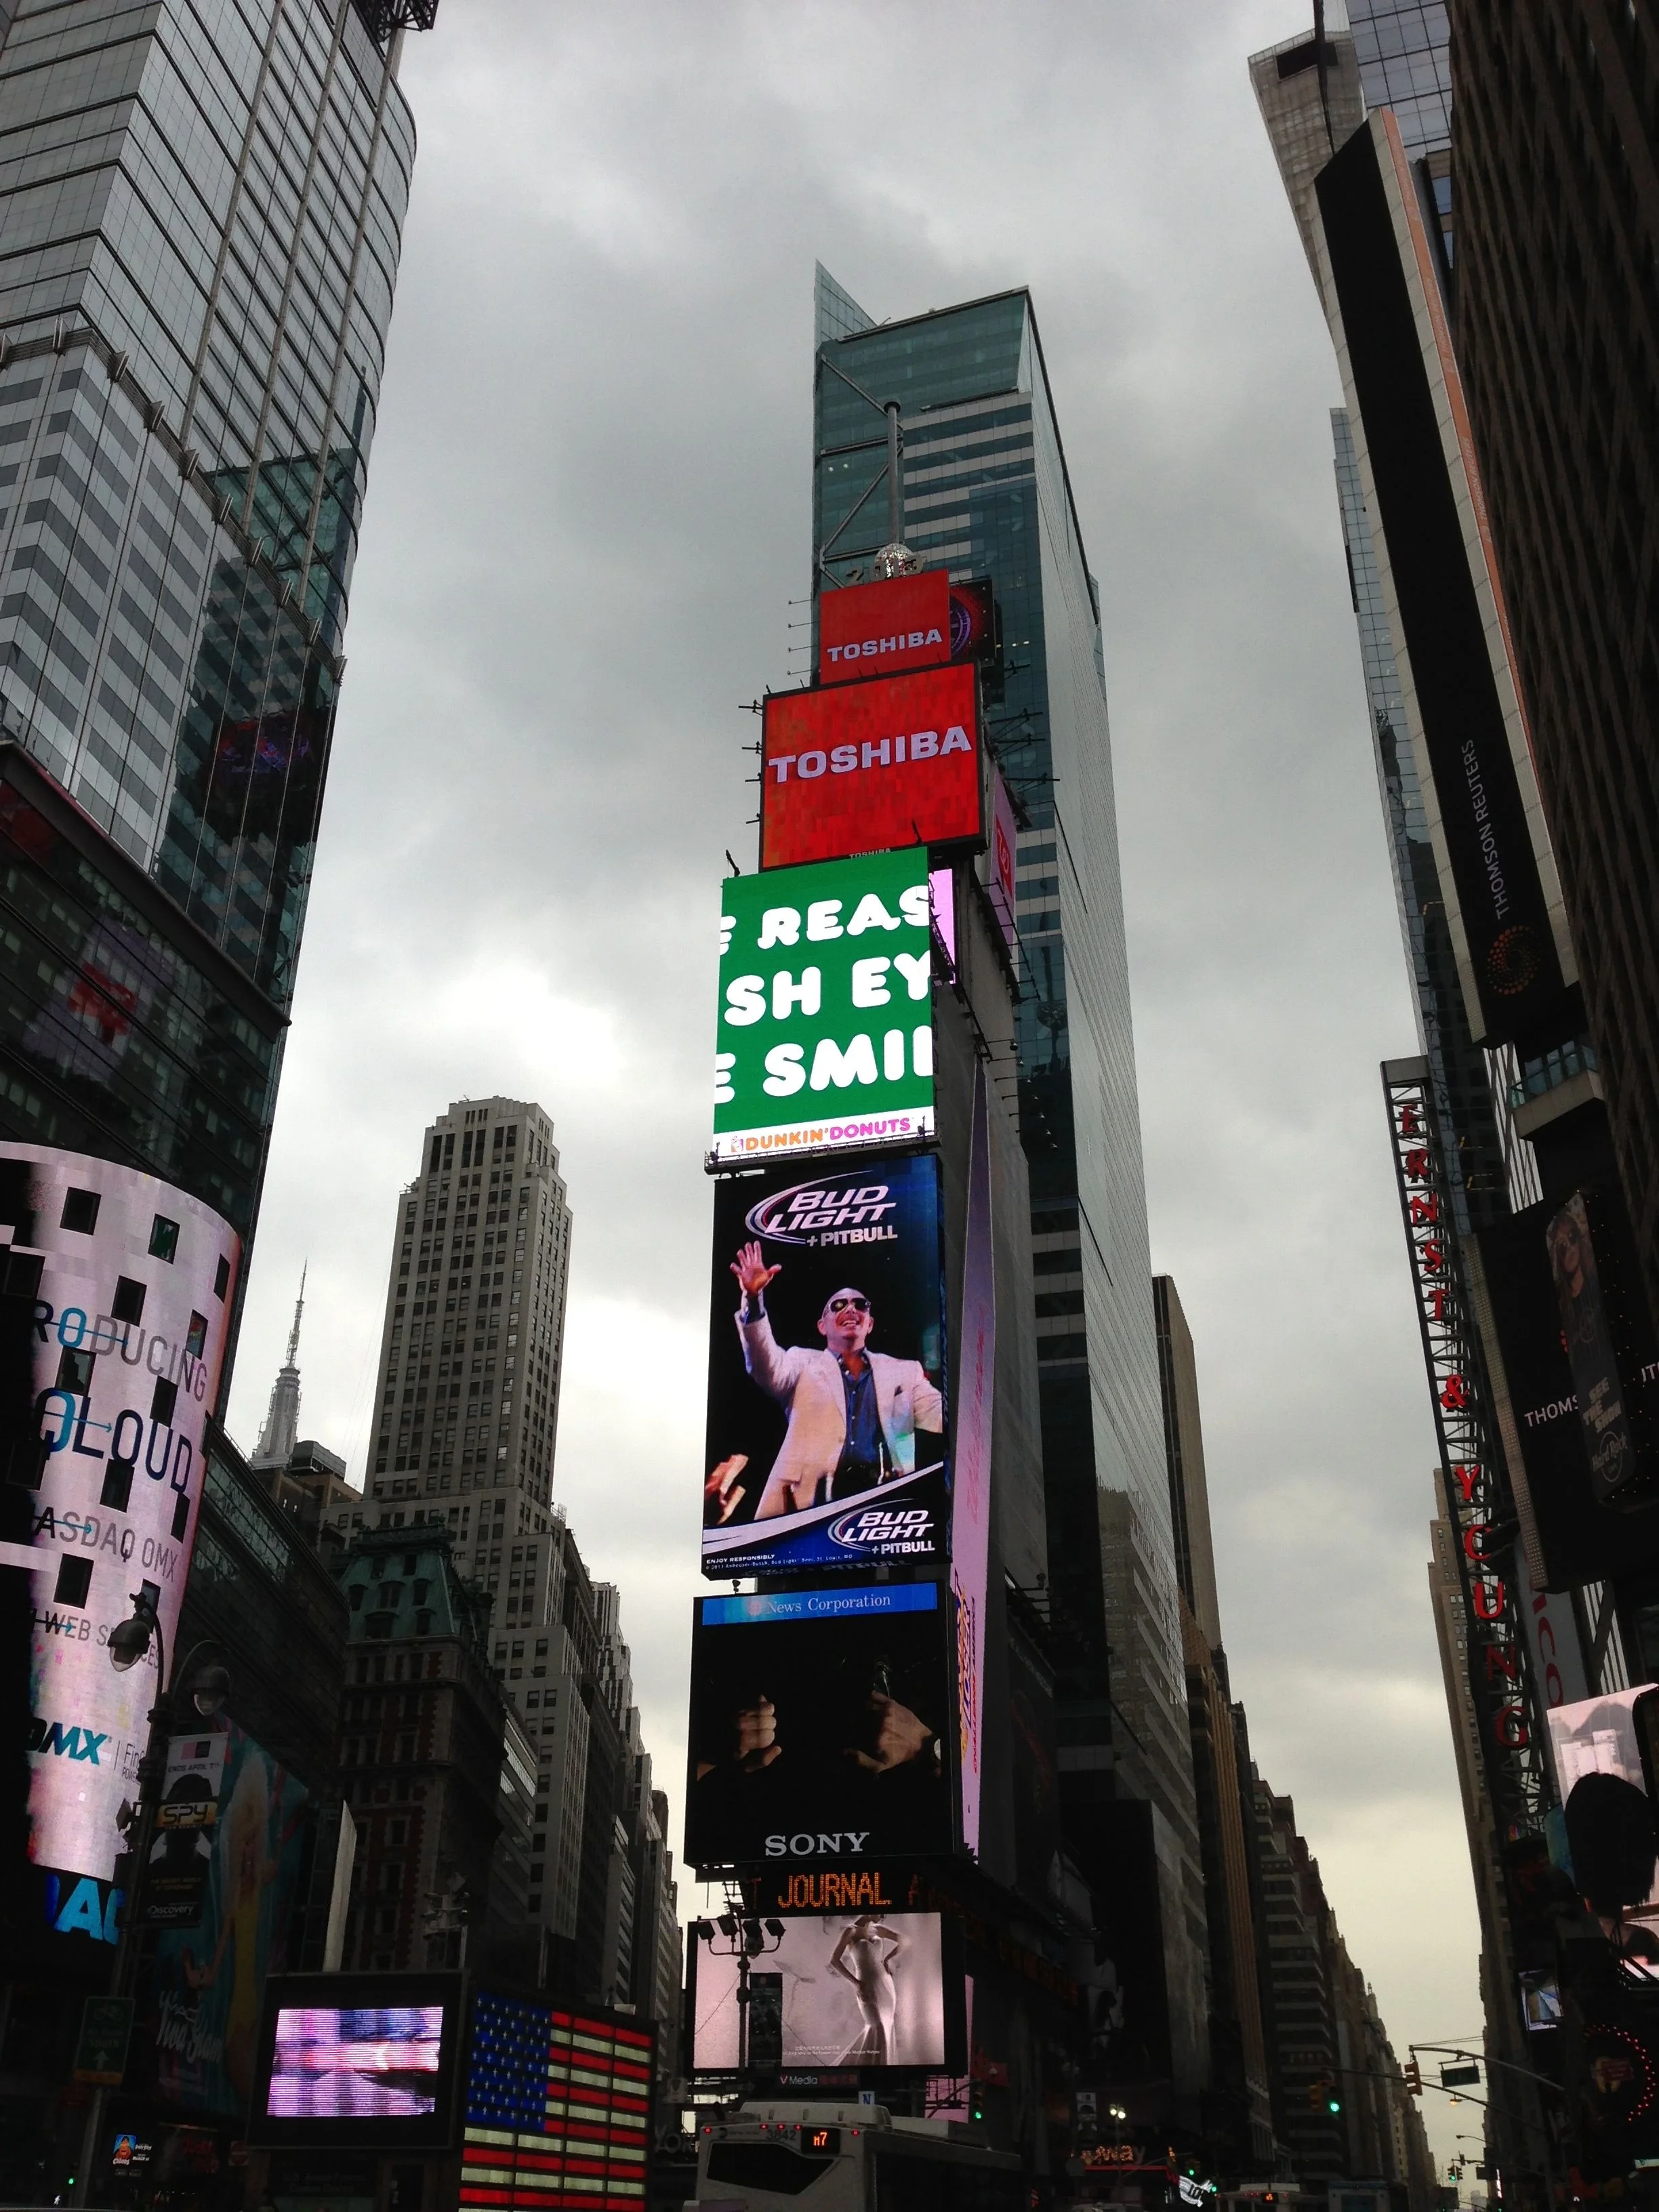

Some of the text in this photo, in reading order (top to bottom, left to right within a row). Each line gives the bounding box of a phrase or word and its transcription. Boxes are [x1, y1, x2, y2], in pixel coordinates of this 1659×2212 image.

[827, 629, 942, 662] TOSHIBA
[769, 725, 972, 783] TOSHIBA
[1462, 739, 1509, 920] THOMSON REUTERS
[757, 885, 928, 949] REAS
[724, 950, 930, 1025] SH EY
[830, 1117, 911, 1140] DONUTS
[787, 1185, 888, 1212] BUD
[764, 1203, 897, 1233] LIGHT
[821, 1225, 897, 1247] PITBULL
[1589, 1377, 1610, 1404] SEE
[1583, 1399, 1603, 1425] THE
[1595, 1400, 1622, 1433] SHOW
[1401, 1105, 1527, 1746] ERNST & YOUNG
[857, 1510, 928, 1528] BUD
[842, 1523, 934, 1542] LIGHT
[142, 1538, 178, 1583] OMX
[730, 1554, 775, 1562] RESPONSIBLY
[881, 1540, 935, 1555] PITBULL
[766, 1593, 890, 1614] News Corporation
[45, 1610, 91, 1641] WEB
[163, 1803, 208, 1824] SPY
[764, 1832, 869, 1857] SONY
[790, 2075, 818, 2085] Media
[813, 2131, 828, 2148] M7
